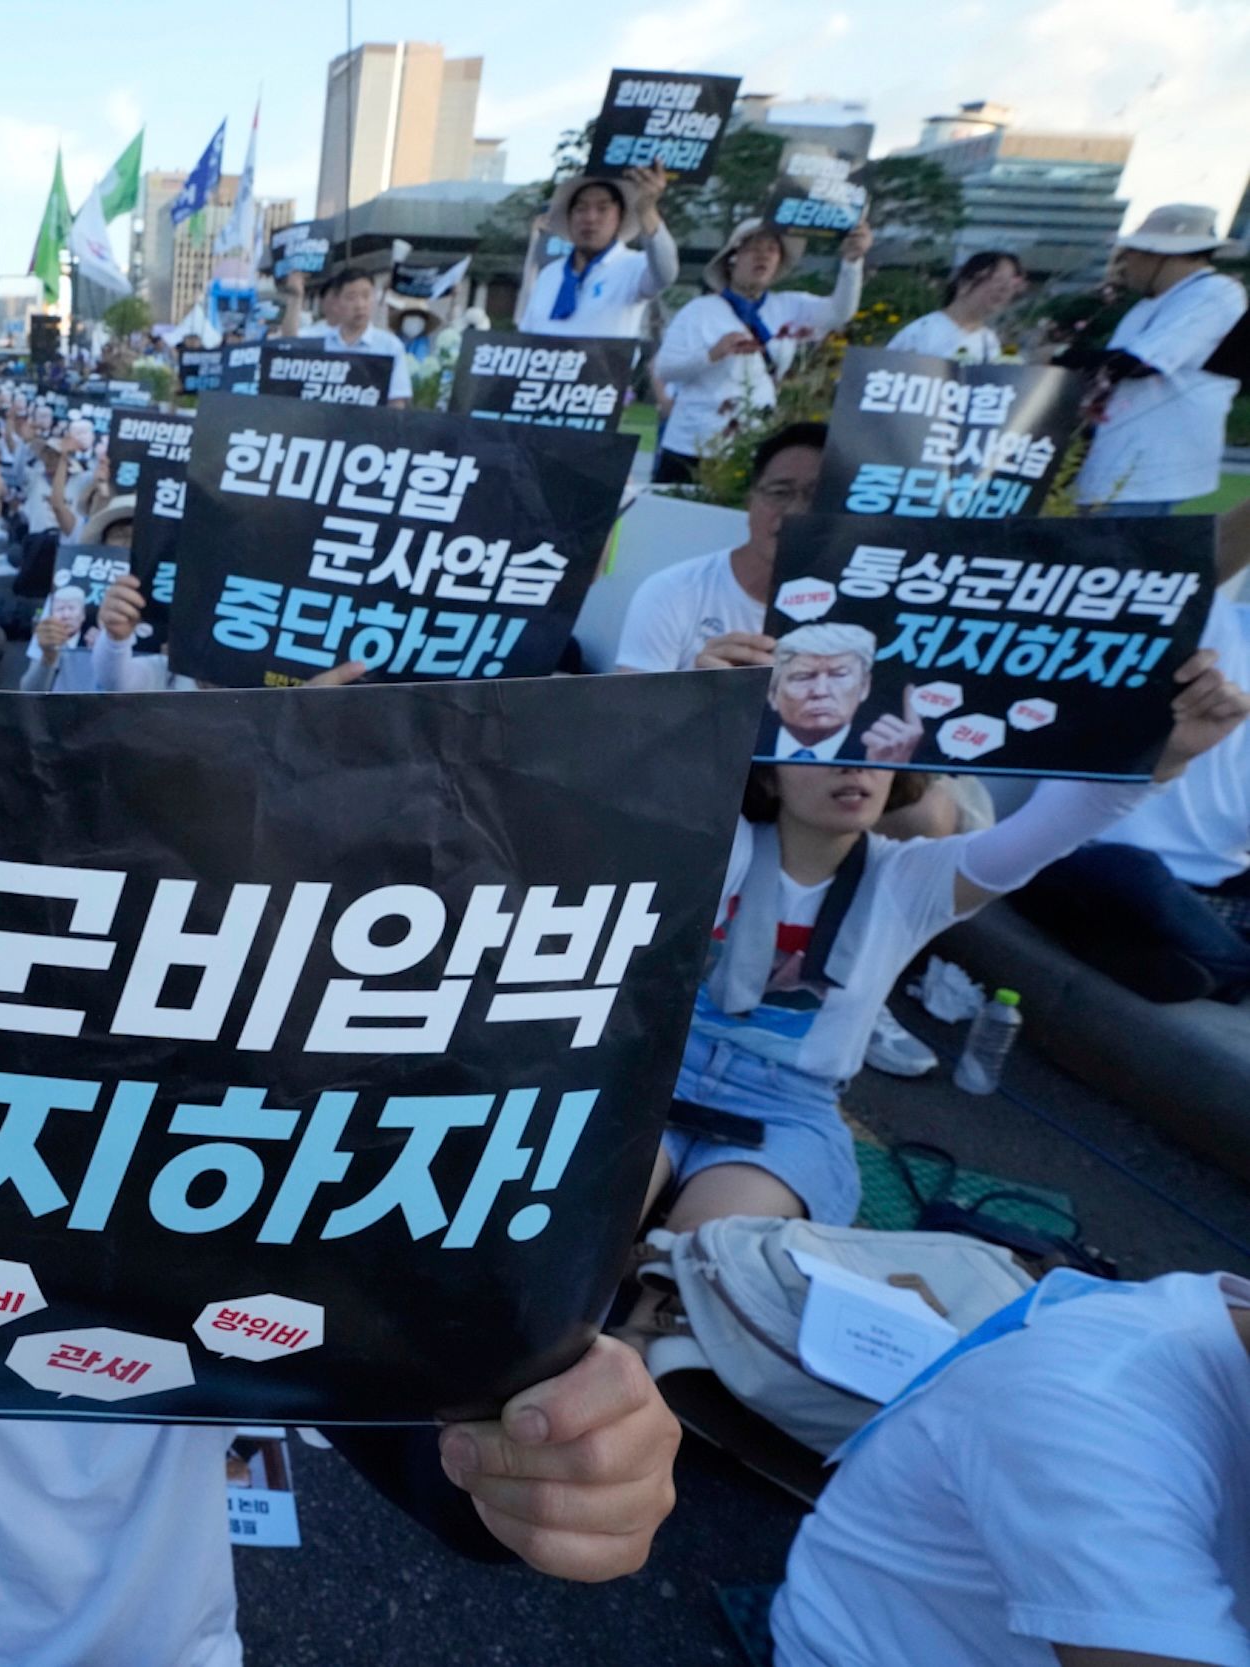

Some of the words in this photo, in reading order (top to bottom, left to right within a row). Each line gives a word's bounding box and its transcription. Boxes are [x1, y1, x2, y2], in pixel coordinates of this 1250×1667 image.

[269, 357, 350, 384] 한미연합
[470, 344, 588, 382] 한미연합
[511, 381, 618, 415] 군사연습
[860, 369, 1016, 424] 한미연합
[219, 428, 480, 523] 한미연합
[921, 422, 1056, 479] 군사연습
[308, 515, 570, 607] 군사연습
[837, 544, 1201, 627] 통상군비압박
[212, 573, 529, 680] 중단하라!
[874, 612, 1173, 690] 저지하자!
[211, 1306, 310, 1350] 방위비
[48, 1342, 153, 1386] 관세
